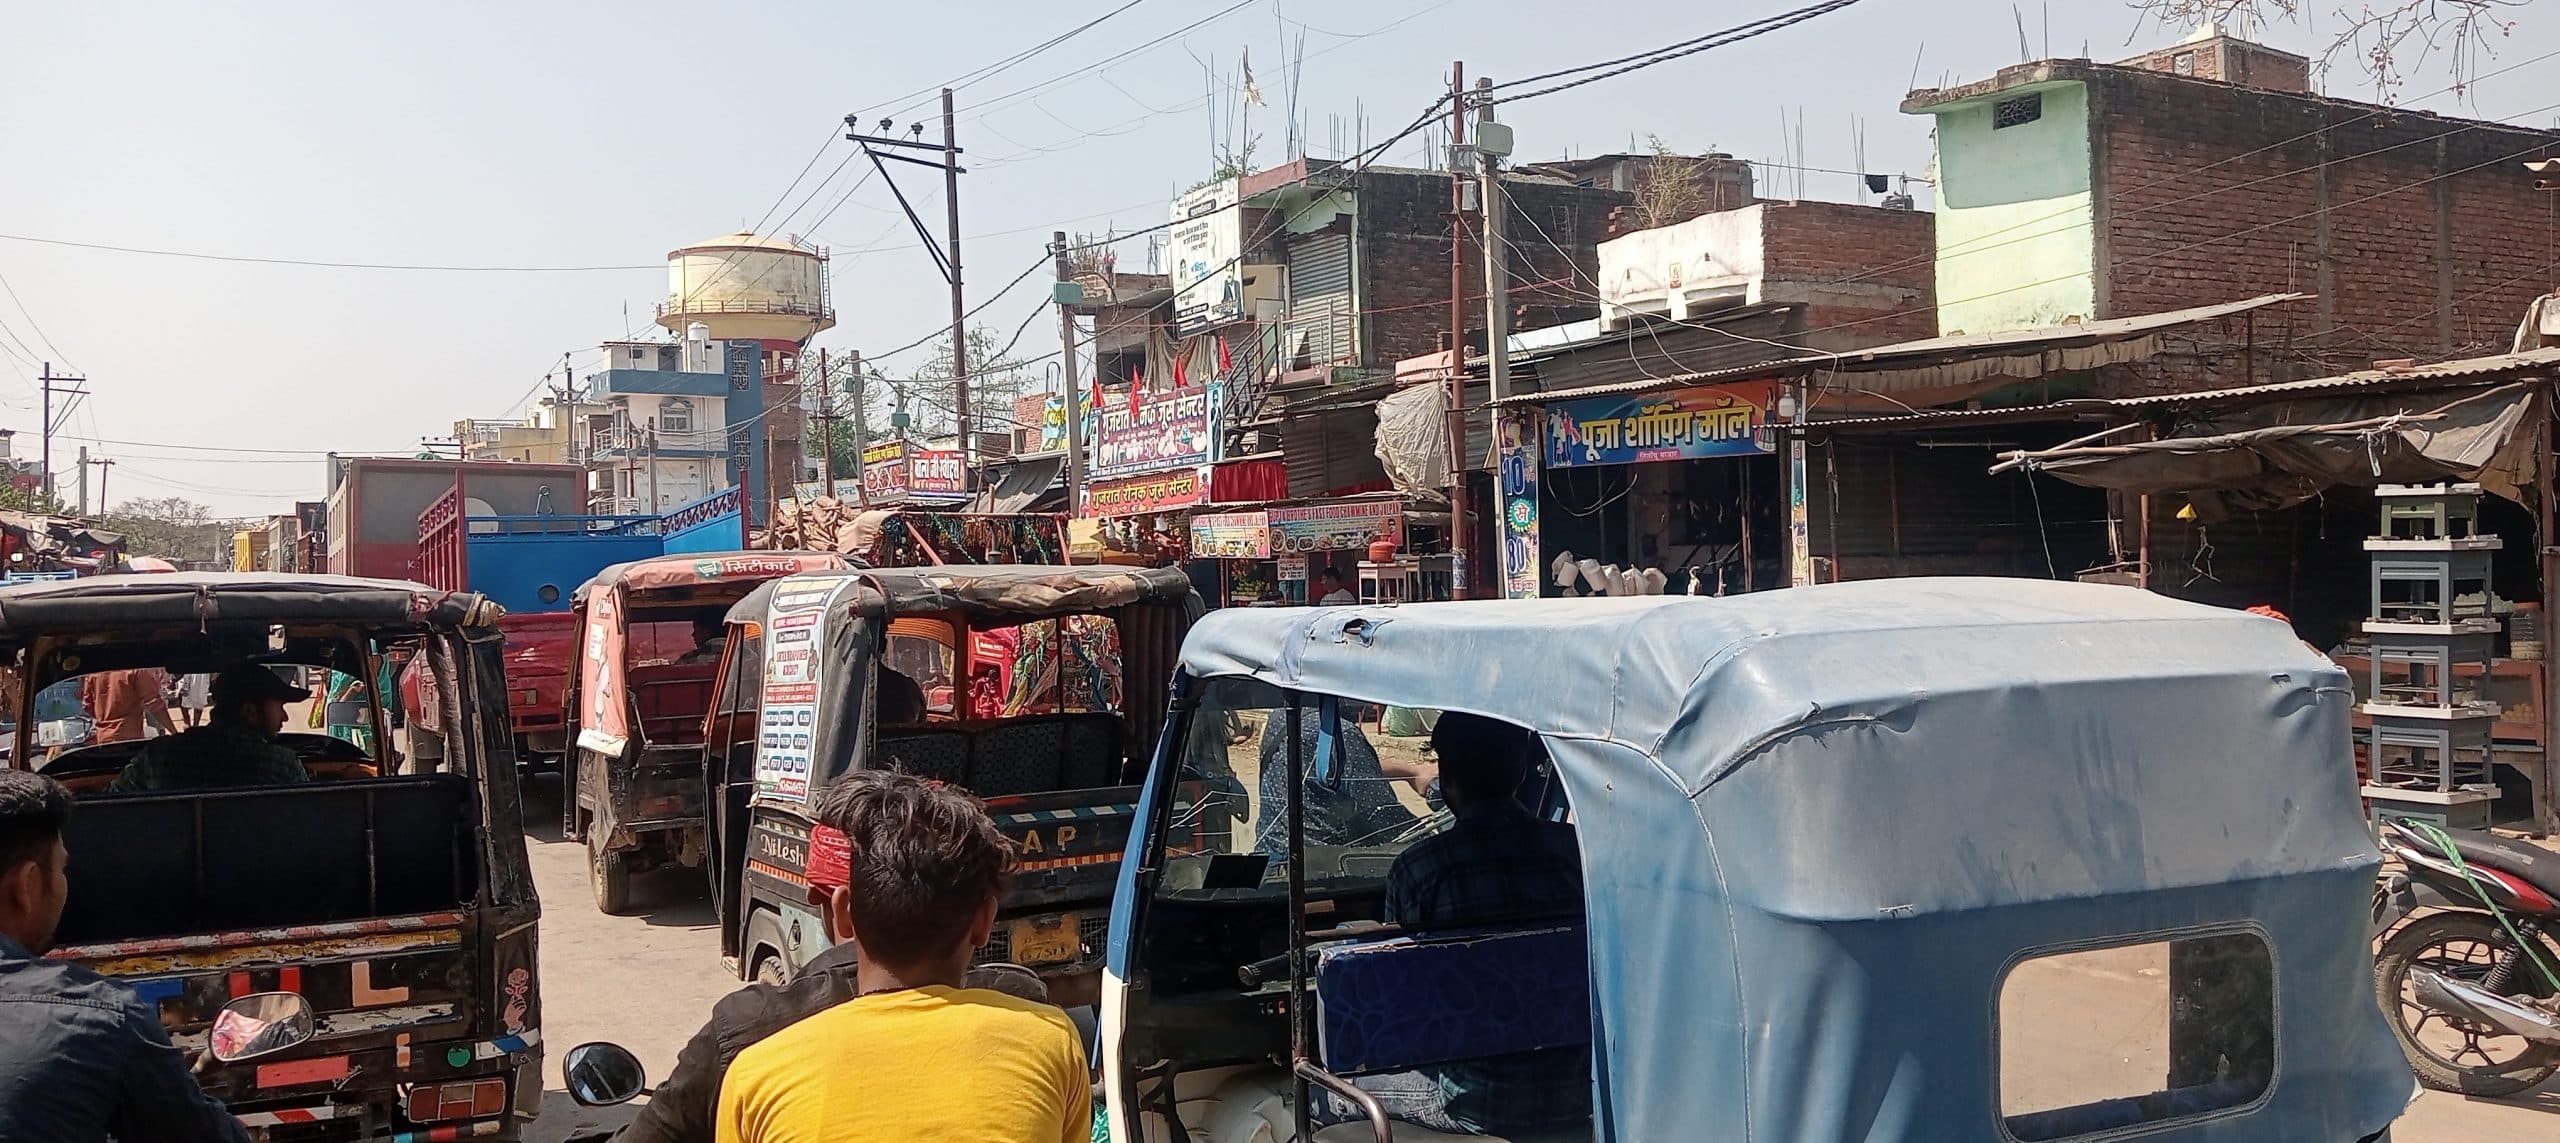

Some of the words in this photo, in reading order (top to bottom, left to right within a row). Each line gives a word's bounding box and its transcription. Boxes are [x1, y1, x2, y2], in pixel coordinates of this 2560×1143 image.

[1102, 409, 1130, 440] गुजरात
[1158, 400, 1176, 430] जूस
[1579, 417, 1622, 462] पूजा
[1624, 401, 1694, 449] शॉपिंग
[1696, 397, 1753, 441] मॉल
[1093, 488, 1121, 510] गुजरात
[1148, 482, 1166, 502] जूस
[1166, 477, 1193, 497] सेन्टर
[1515, 502, 1529, 523] से
[726, 559, 795, 573] सिटीकार्ट
[760, 834, 806, 867] Nilesh
